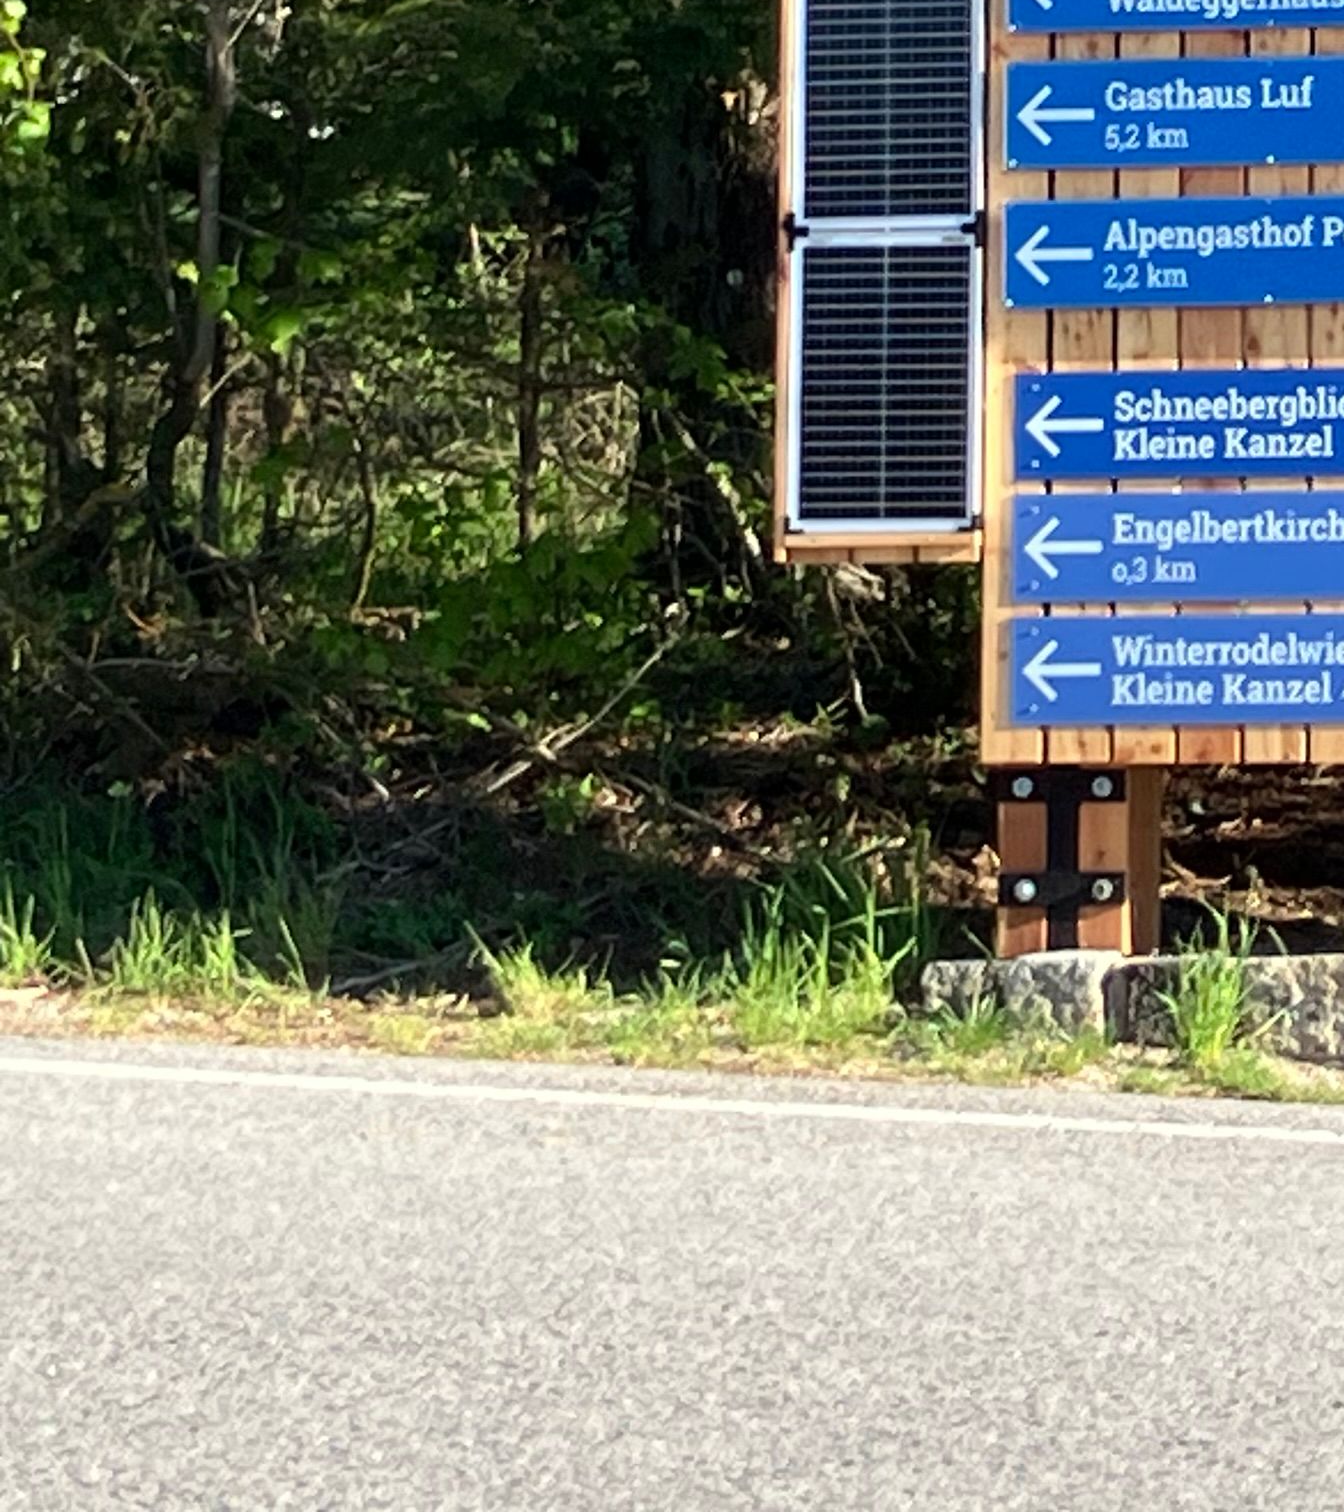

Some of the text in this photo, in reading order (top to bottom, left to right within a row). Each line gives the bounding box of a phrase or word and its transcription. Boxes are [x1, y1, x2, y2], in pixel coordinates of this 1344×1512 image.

[1105, 76, 1314, 112] Gasthaus Luf
[1104, 123, 1189, 151] 5,2 km
[1104, 216, 1315, 256] Alpengasthof
[1103, 263, 1189, 292] 2,2 km
[1113, 428, 1215, 461] Kleine
[1223, 426, 1334, 459] Kanzel
[1152, 556, 1196, 582] km
[1111, 674, 1213, 706] Kleine
[1222, 673, 1332, 705] Kanzel
